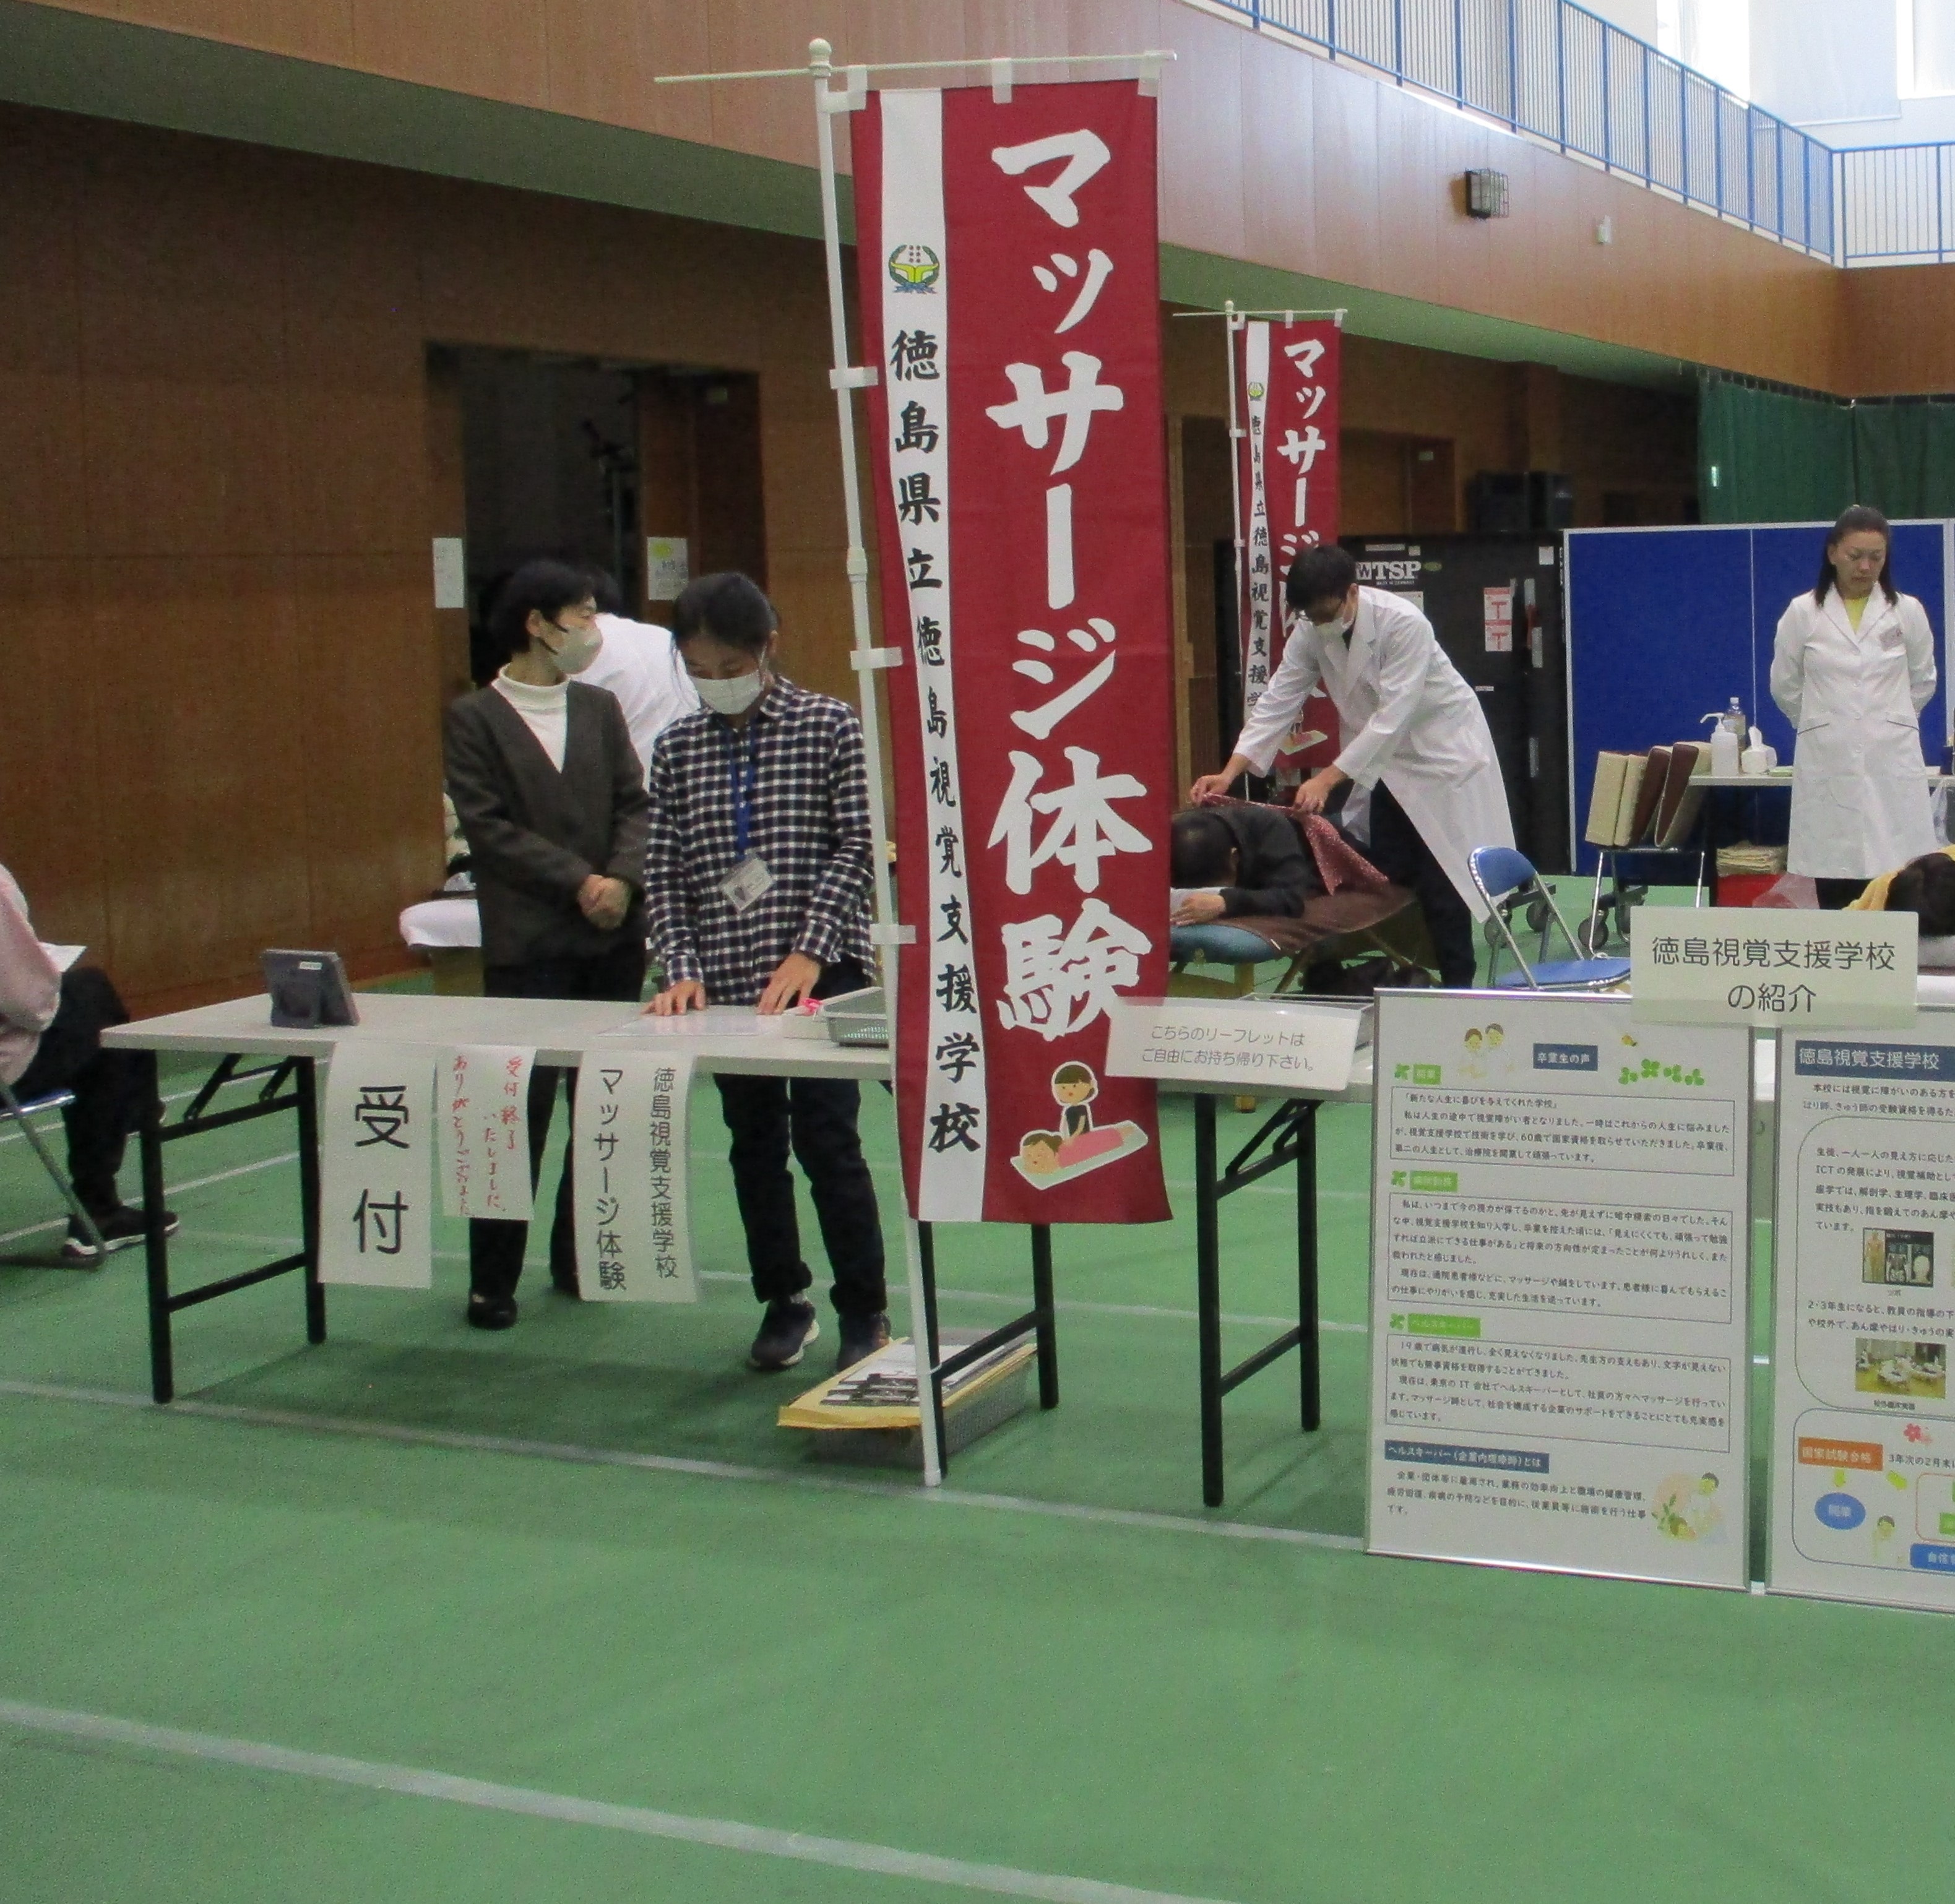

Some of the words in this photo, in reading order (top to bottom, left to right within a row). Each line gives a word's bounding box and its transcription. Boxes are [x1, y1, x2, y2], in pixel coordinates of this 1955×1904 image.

[1276, 339, 1326, 698] マッサージ
[986, 128, 1153, 1040] マッサージ体験
[890, 330, 981, 1153] 徳島県立徳島視覚支援学校
[1651, 936, 1896, 971] 徳島視覚支援学校
[1727, 983, 1817, 1013] の紹介
[1151, 1025, 1306, 1046] こちらのリーフレットは
[1142, 1048, 1313, 1072] ご自由にお持ち帰り下さい。
[1537, 1052, 1590, 1065] 卒業生の声
[1798, 1047, 1940, 1070] 徳島視覚支援学校
[1803, 1100, 1955, 1118] はり師、きゅう師の受験資格を得るた
[353, 1085, 410, 1255] 受付
[593, 1069, 626, 1292] マッサージ体験
[649, 1067, 678, 1280] 徳島視覚支援学校
[1888, 1453, 1955, 1469] 3年次の2月末
